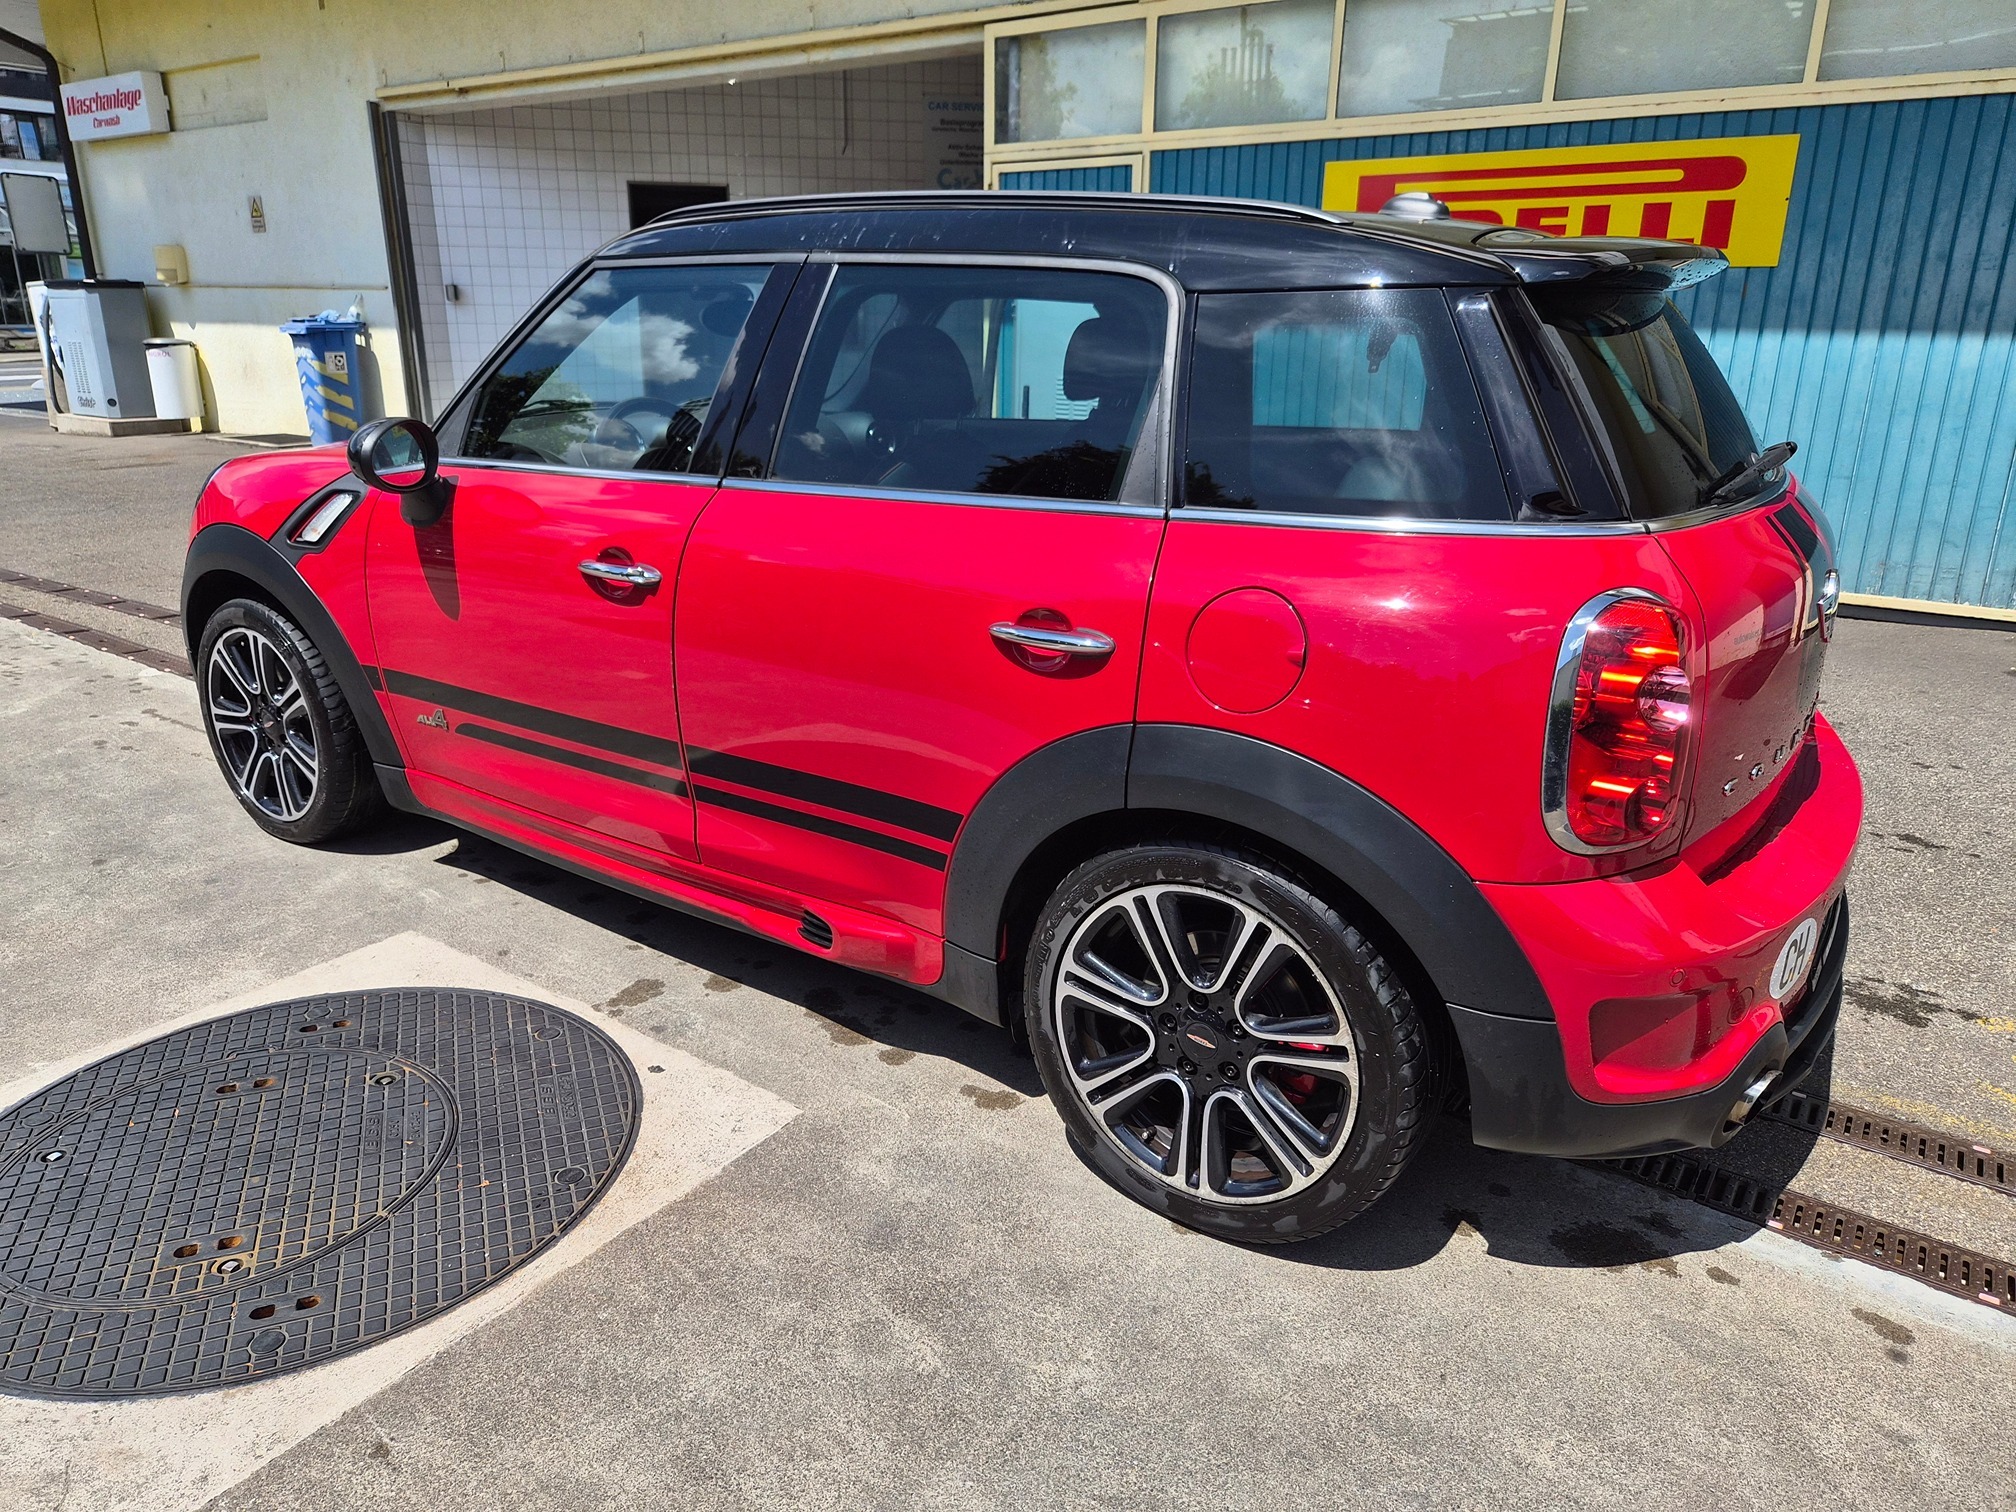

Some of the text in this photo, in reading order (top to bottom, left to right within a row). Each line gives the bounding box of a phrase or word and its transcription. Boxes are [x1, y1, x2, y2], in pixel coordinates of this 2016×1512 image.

[66, 88, 142, 116] Waschanlage
[928, 102, 984, 111] CAR SERVIC
[92, 114, 121, 129] Carwash
[1356, 156, 1747, 249] PELLI
[1779, 924, 1813, 991] CH
